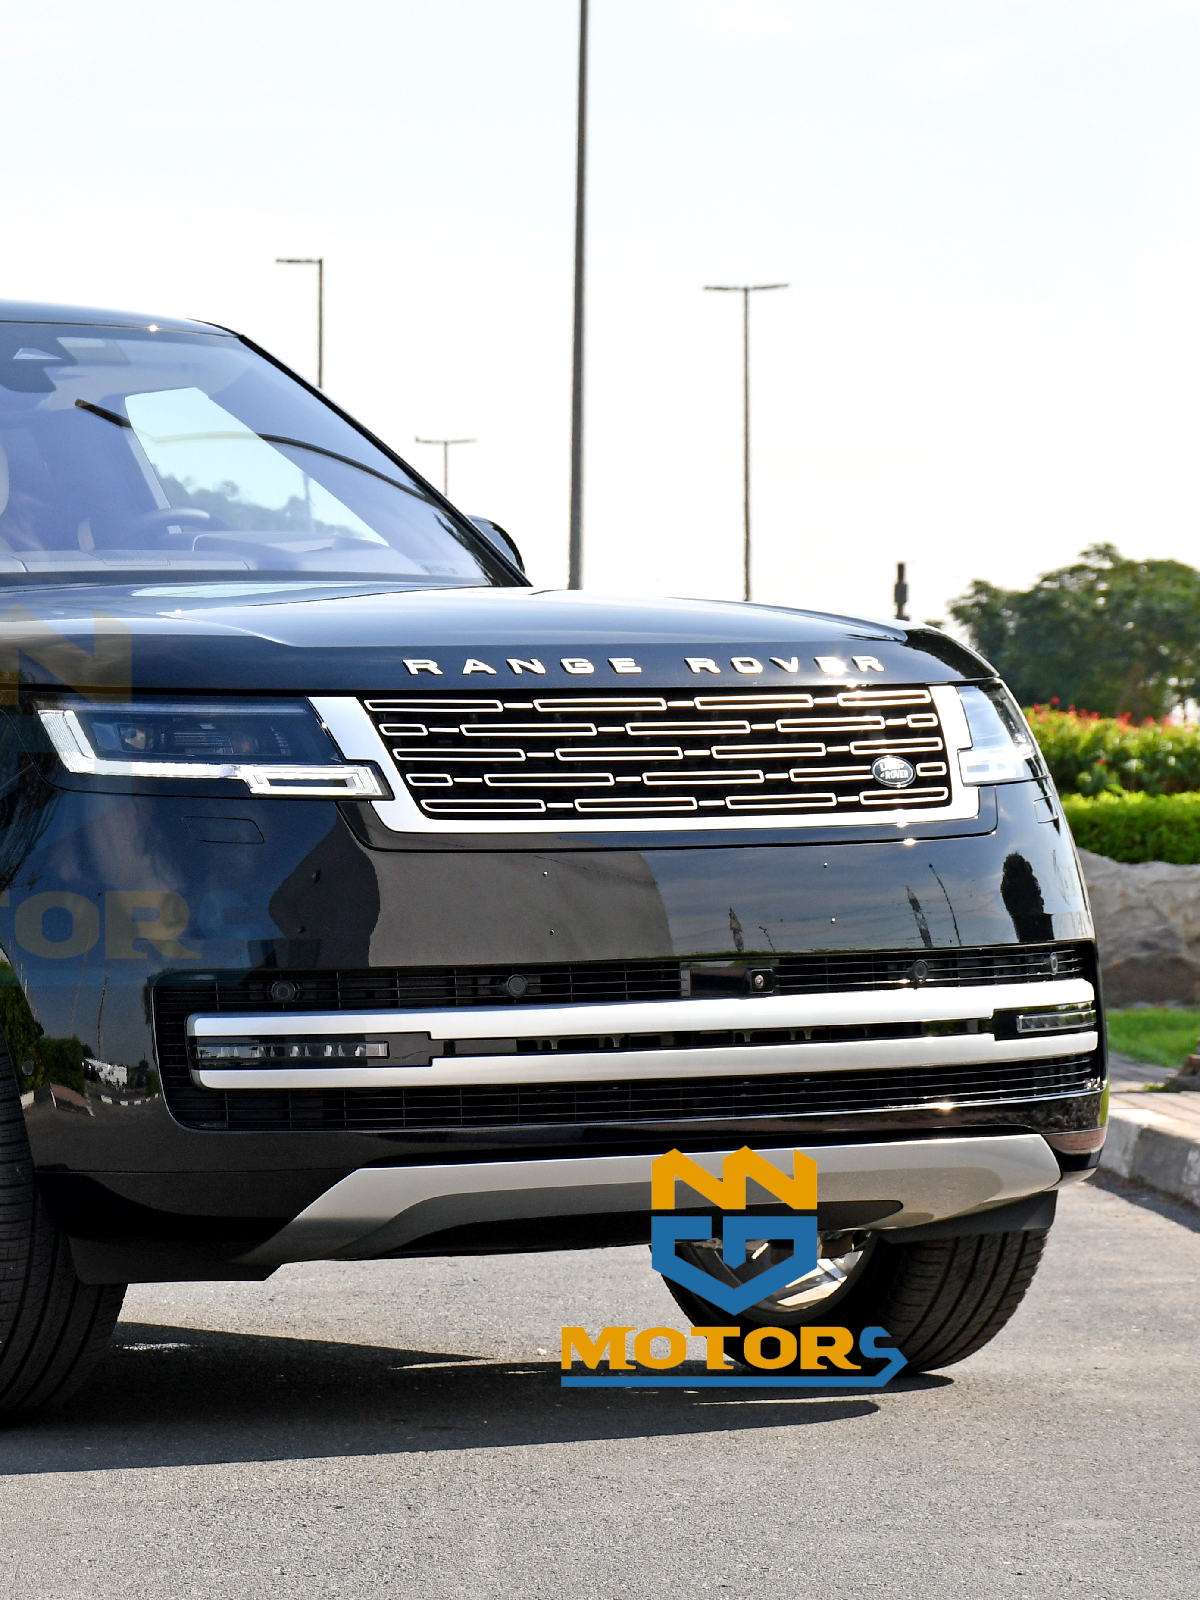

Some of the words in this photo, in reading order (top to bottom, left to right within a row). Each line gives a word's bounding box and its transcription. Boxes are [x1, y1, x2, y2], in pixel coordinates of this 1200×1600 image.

[402, 656, 643, 676] RANGE
[684, 654, 886, 676] ROVER
[885, 769, 909, 780] ROVER
